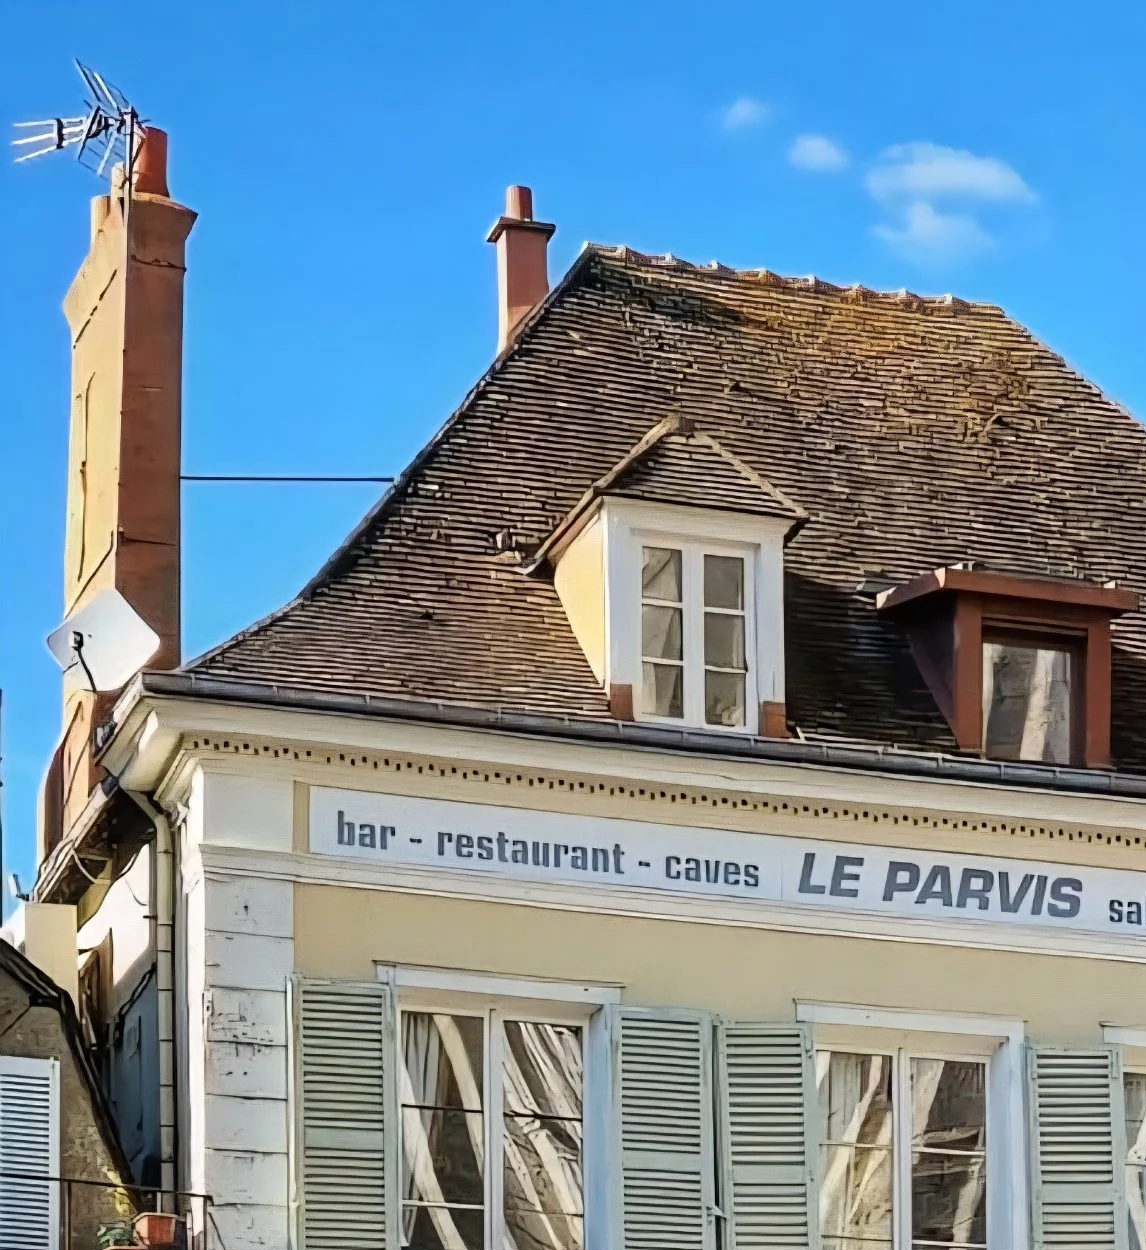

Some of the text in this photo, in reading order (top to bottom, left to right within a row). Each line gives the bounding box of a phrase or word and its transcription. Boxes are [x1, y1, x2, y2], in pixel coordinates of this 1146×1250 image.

[337, 810, 396, 850] bar
[437, 831, 625, 875] restaurant
[664, 854, 760, 888] caves
[798, 852, 1083, 918] LE PARVIS
